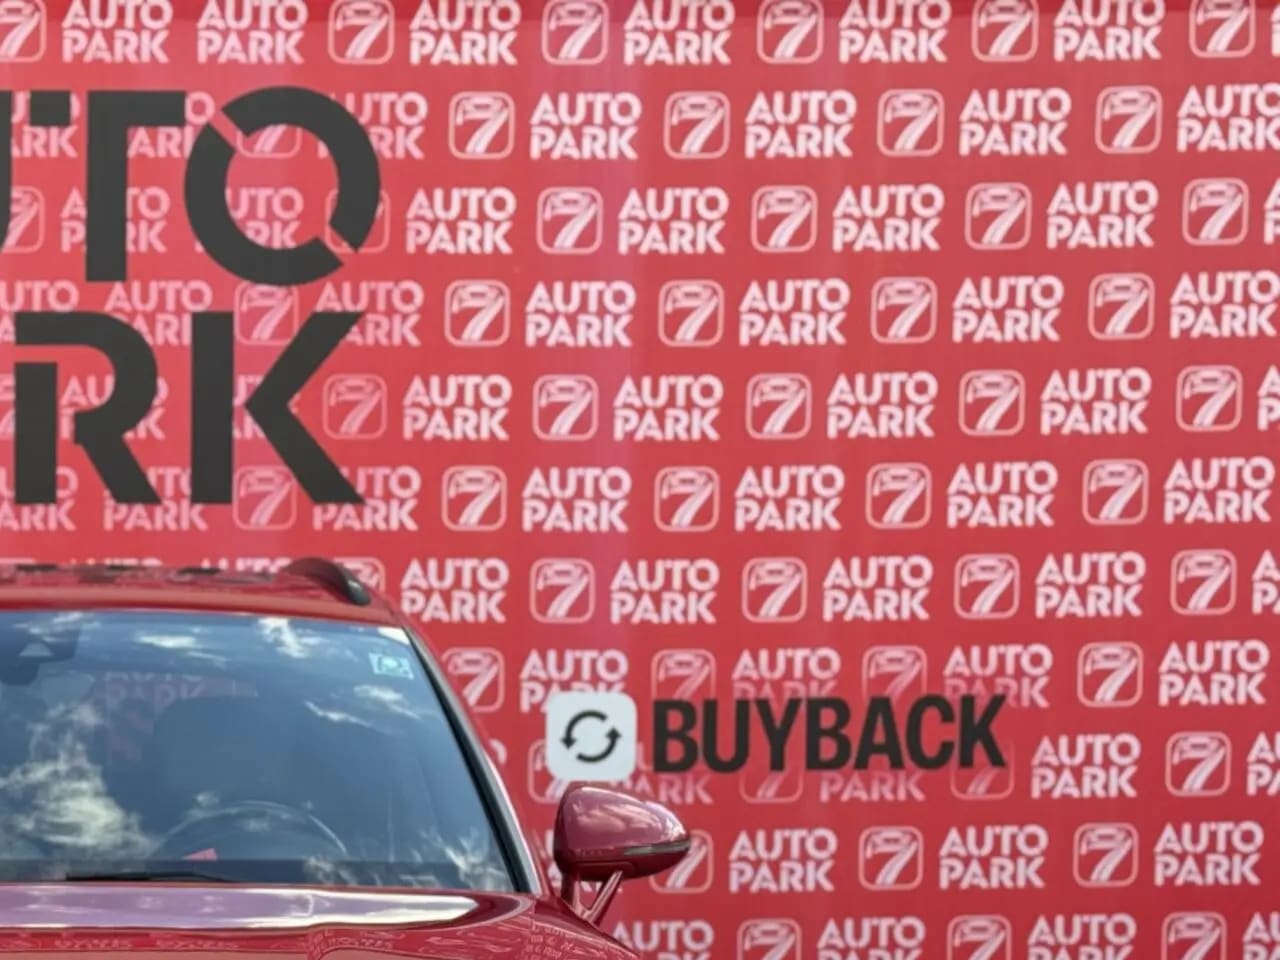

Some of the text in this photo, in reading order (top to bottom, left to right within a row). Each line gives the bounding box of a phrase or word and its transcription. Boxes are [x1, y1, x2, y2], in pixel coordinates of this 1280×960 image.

[62, 0, 172, 29] AUTO
[197, 0, 307, 30] AUTO
[410, 0, 520, 31] AUTO
[624, 0, 734, 31] AUTO
[839, 0, 950, 29] AUTO
[63, 29, 168, 63] PARK
[198, 28, 303, 64] PARK
[410, 30, 516, 65] PARK
[624, 30, 730, 65] PARK
[839, 28, 946, 63] PARK
[1053, 27, 1162, 62] PARK
[531, 92, 641, 125] AUTO
[746, 90, 856, 125] AUTO
[960, 88, 1071, 122] AUTO
[531, 125, 637, 159] PARK
[746, 122, 852, 158] PARK
[960, 121, 1067, 155] PARK
[407, 188, 516, 221] AUTO
[619, 187, 728, 221] AUTO
[833, 184, 944, 218] AUTO
[1048, 181, 1158, 215] AUTO
[407, 220, 511, 254] PARK
[618, 220, 724, 254] PARK
[833, 217, 939, 251] PARK
[1047, 214, 1153, 248] PARK
[526, 281, 636, 313] AUTO
[740, 278, 850, 313] AUTO
[953, 276, 1064, 309] AUTO
[1171, 271, 1280, 306] AUTO
[526, 313, 632, 347] PARK
[740, 310, 845, 345] PARK
[953, 308, 1060, 342] PARK
[1170, 303, 1276, 338] PARK
[404, 375, 512, 407] AUTO
[614, 375, 723, 408] AUTO
[828, 372, 937, 405] AUTO
[1041, 368, 1151, 402] AUTO
[404, 407, 508, 440] PARK
[614, 407, 719, 441] PARK
[827, 404, 933, 438] PARK
[1041, 401, 1147, 435] PARK
[523, 467, 631, 499] AUTO
[735, 465, 844, 498] AUTO
[948, 461, 1058, 495] AUTO
[1164, 457, 1275, 491] AUTO
[523, 498, 627, 532] PARK
[736, 497, 840, 531] PARK
[948, 494, 1053, 527] PARK
[1164, 488, 1270, 523] PARK
[401, 558, 509, 590] AUTO
[611, 559, 719, 592] AUTO
[823, 556, 933, 589] AUTO
[1036, 552, 1145, 586] AUTO
[611, 591, 715, 624] PARK
[823, 588, 928, 621] PARK
[1036, 584, 1141, 618] PARK
[1159, 640, 1269, 673] AUTO
[1159, 672, 1265, 706] PARK
[653, 695, 1006, 774] BUYBACK
[1032, 733, 1140, 766] AUTO
[1032, 764, 1136, 798] PARK
[729, 828, 837, 862] AUTO
[940, 825, 1048, 857] AUTO
[1154, 821, 1264, 854] AUTO
[730, 859, 833, 892] PARK
[940, 856, 1044, 889] PARK
[1155, 853, 1259, 886] PARK
[817, 917, 925, 949] AUTO
[1028, 913, 1136, 946] AUTO
